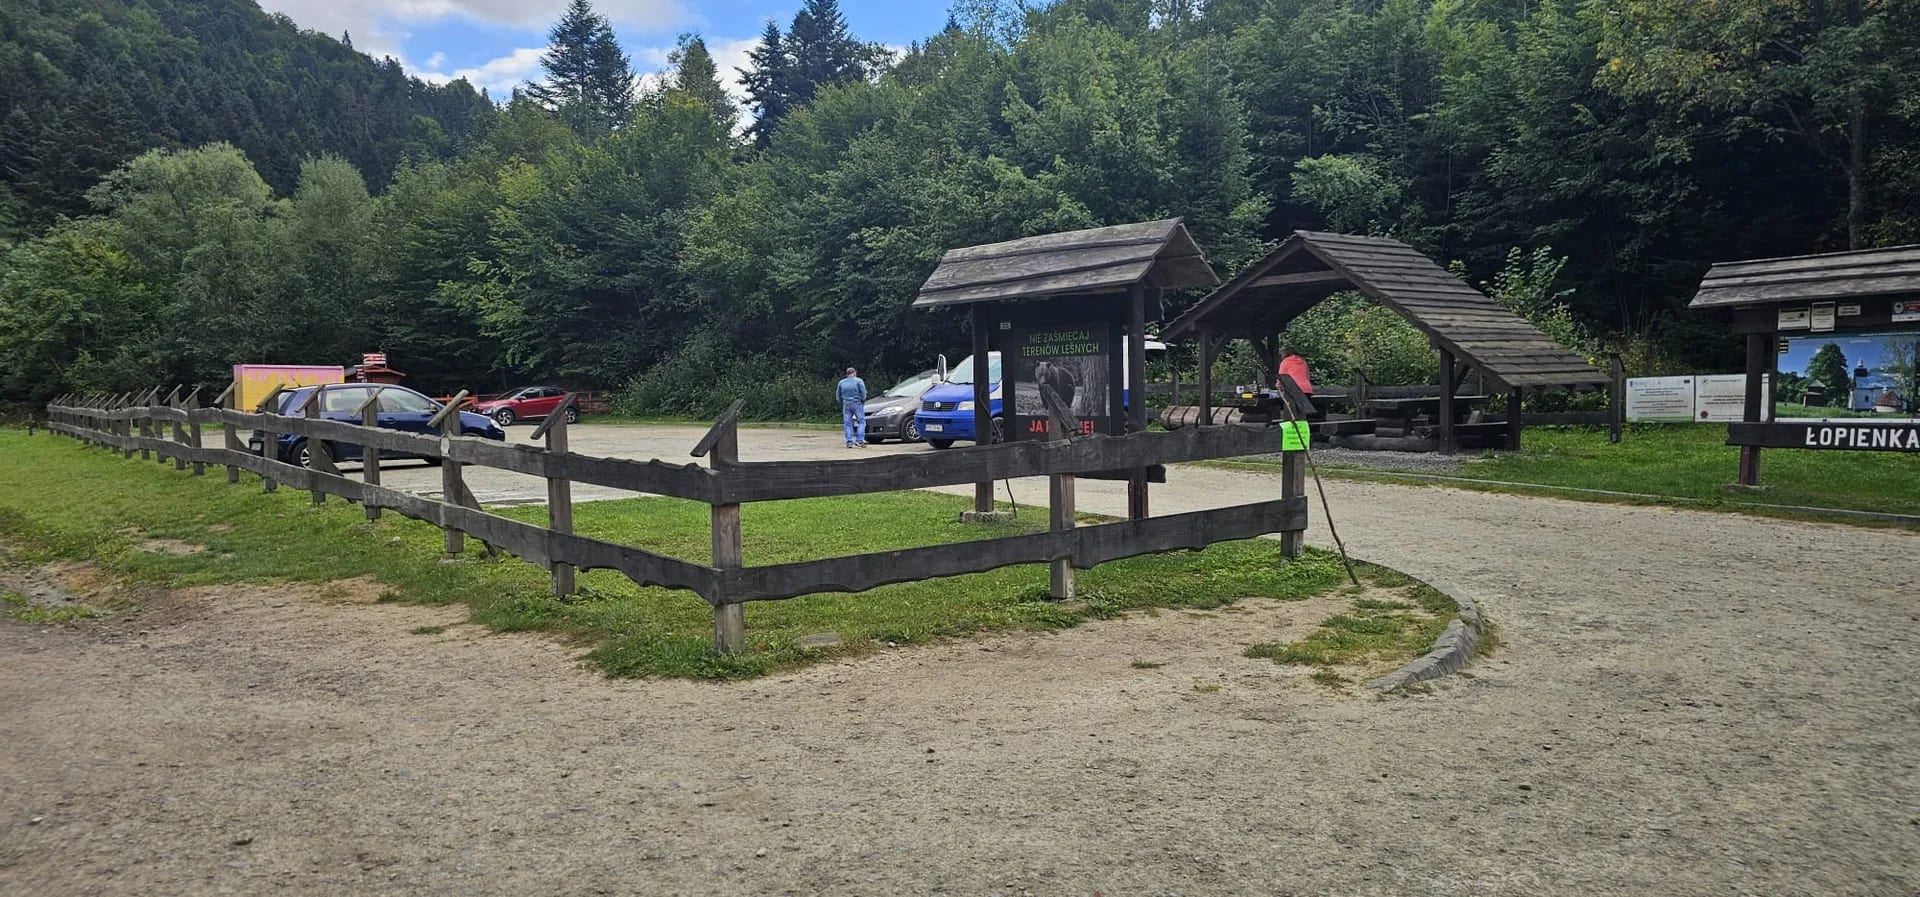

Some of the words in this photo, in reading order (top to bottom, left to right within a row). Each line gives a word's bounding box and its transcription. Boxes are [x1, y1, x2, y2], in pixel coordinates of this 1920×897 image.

[1029, 333, 1042, 344] NIE
[1043, 329, 1090, 343] ZAŚMIECAJ
[1022, 343, 1060, 357] TERENÓW
[1061, 341, 1099, 355] LEŚNYCH
[1029, 420, 1043, 433] JA
[1805, 427, 1920, 449] ŁOPIENKA
